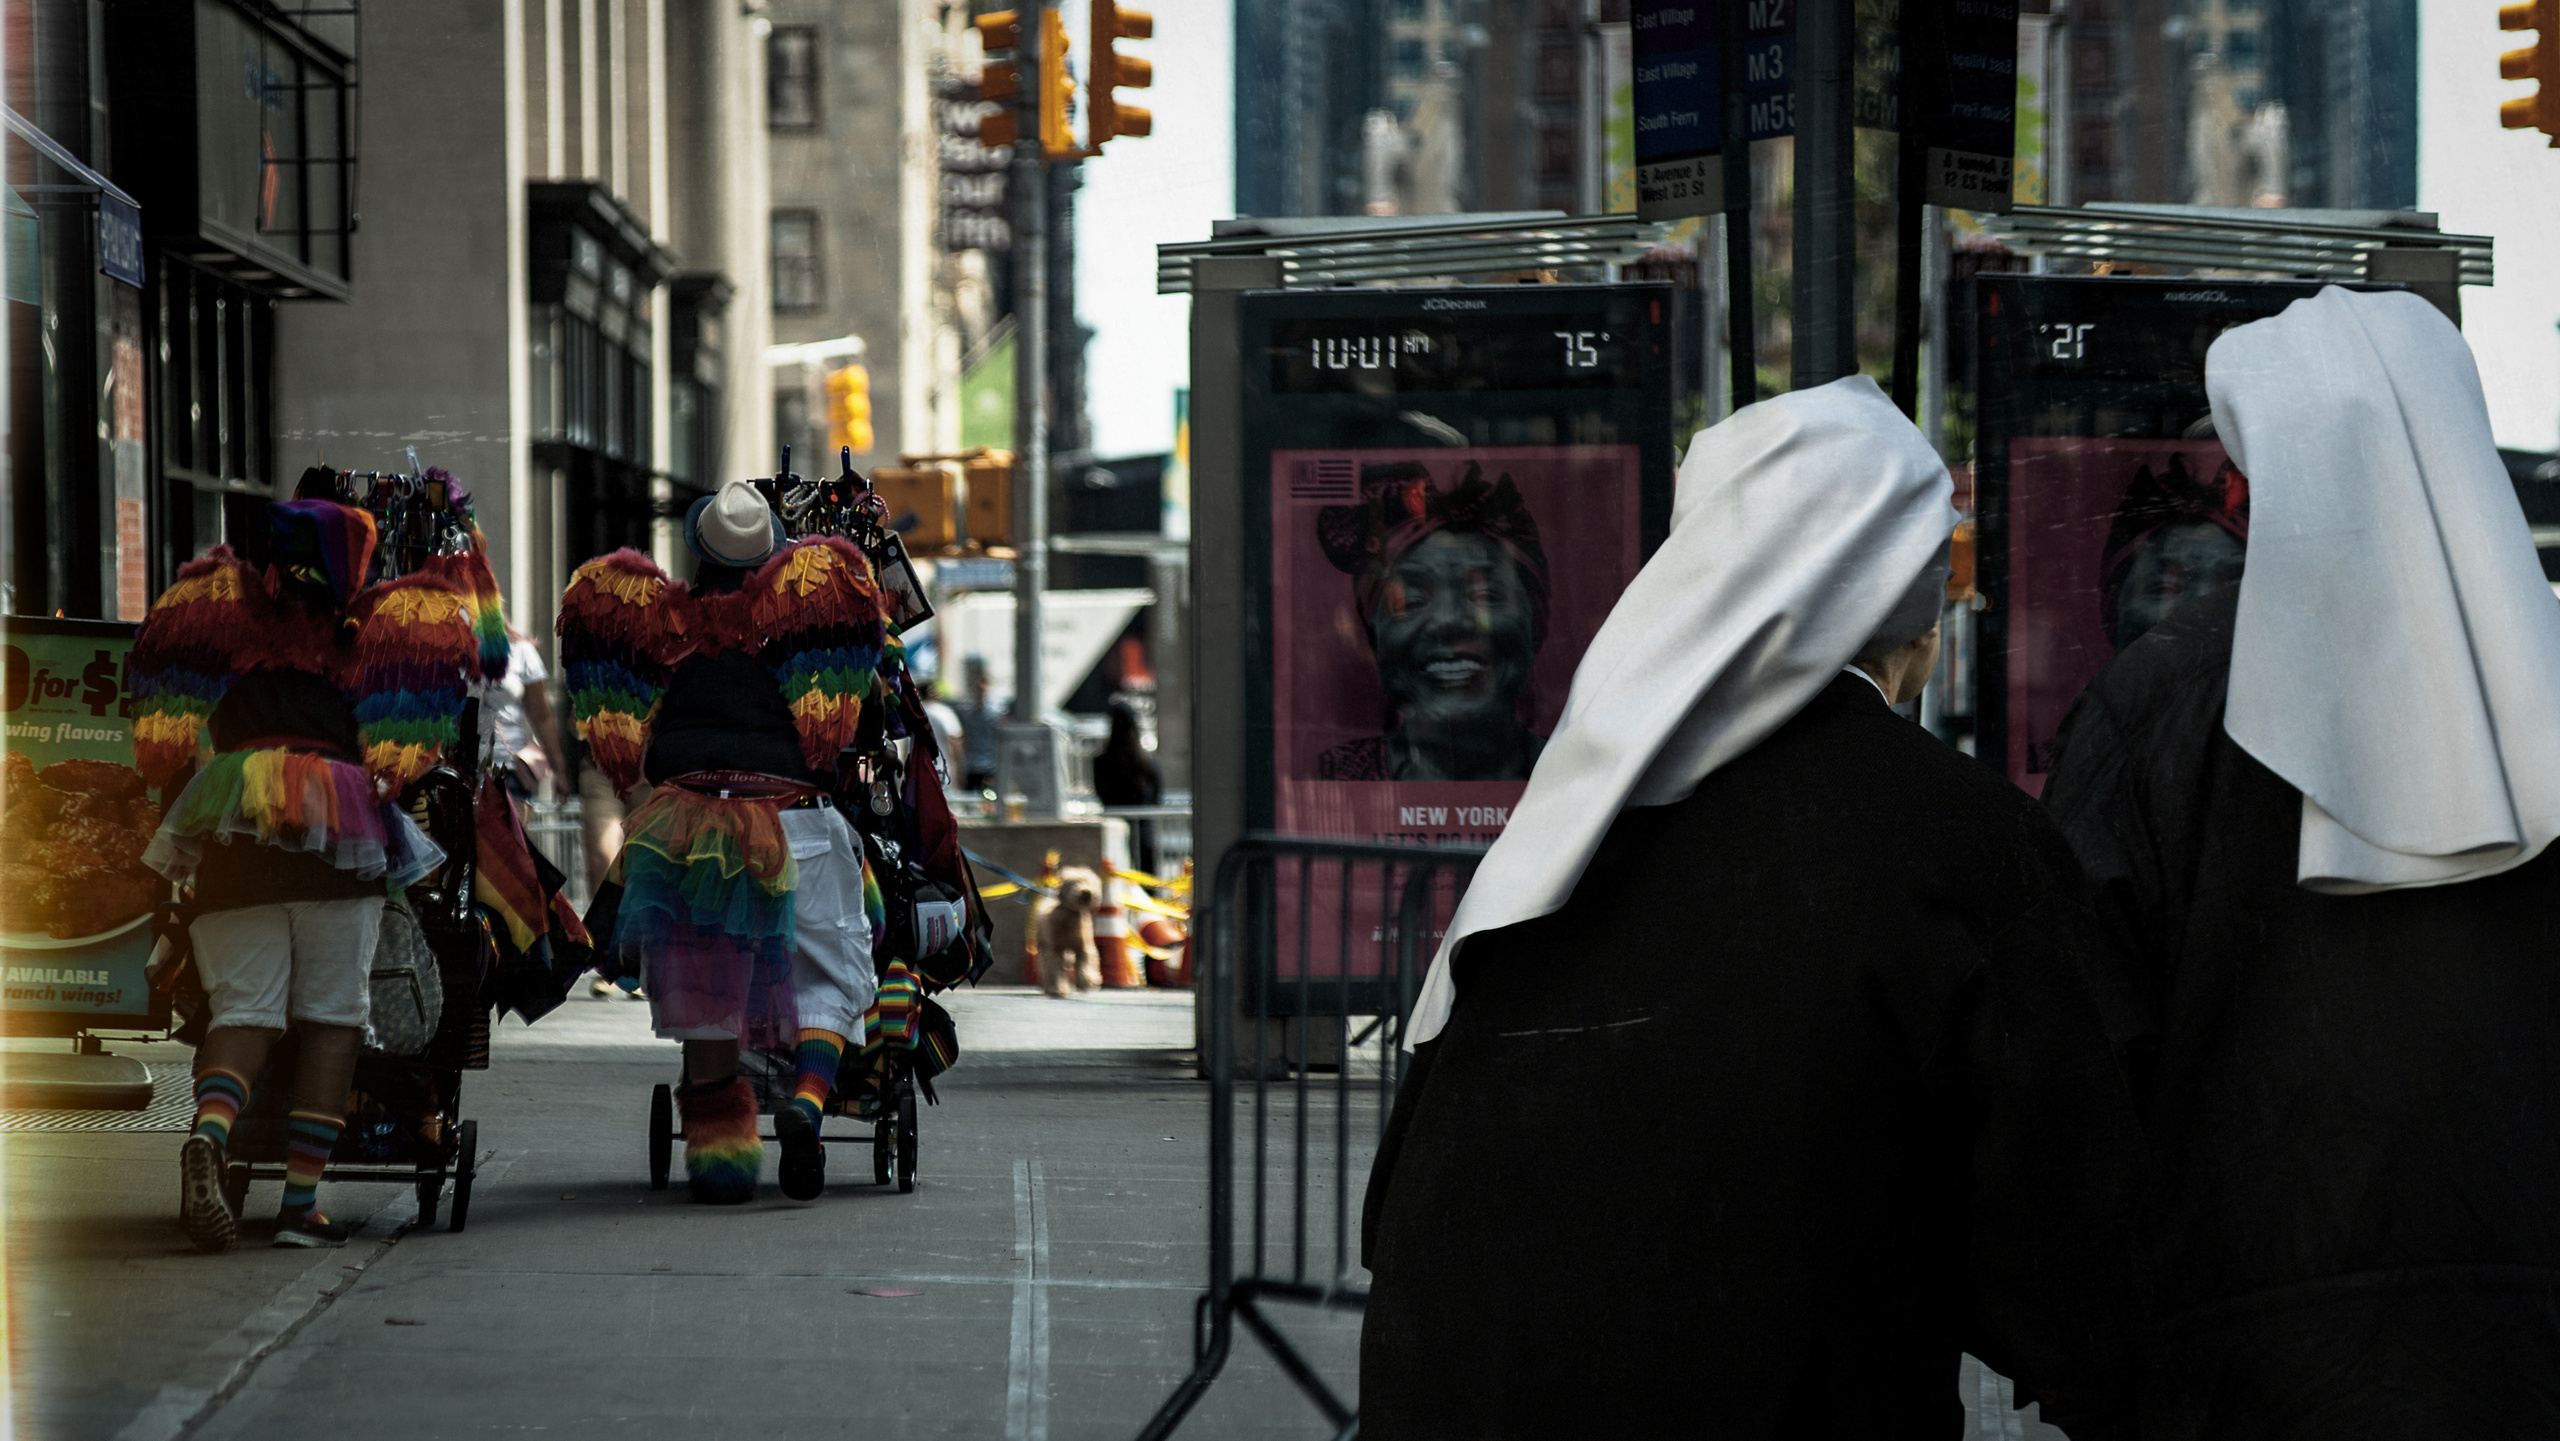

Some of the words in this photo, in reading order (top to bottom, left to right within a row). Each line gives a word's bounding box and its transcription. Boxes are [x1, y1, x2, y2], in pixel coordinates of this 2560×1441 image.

[1636, 13, 1658, 30] East
[1659, 8, 1695, 26] Village
[1749, 0, 1785, 31] M2
[1637, 67, 1660, 83] East
[1662, 63, 1698, 80] Village
[1749, 45, 1783, 82] M3
[1638, 113, 1669, 132] South
[1670, 111, 1699, 128] Ferry
[1640, 169, 1648, 185] 5
[1654, 165, 1692, 183] Avenue
[1641, 186, 1668, 203] West
[1673, 183, 1687, 198] 23
[1693, 180, 1704, 196] St
[1420, 298, 1487, 310] JCDecaux
[1311, 336, 1397, 370] 10:01
[31, 668, 79, 704] for
[6, 721, 52, 743] wing
[56, 723, 124, 743] flavors
[1401, 806, 1448, 826] NEW
[6, 967, 109, 985] AVAILABLE
[4, 985, 55, 1001] ranch
[61, 987, 122, 1007] wings!
